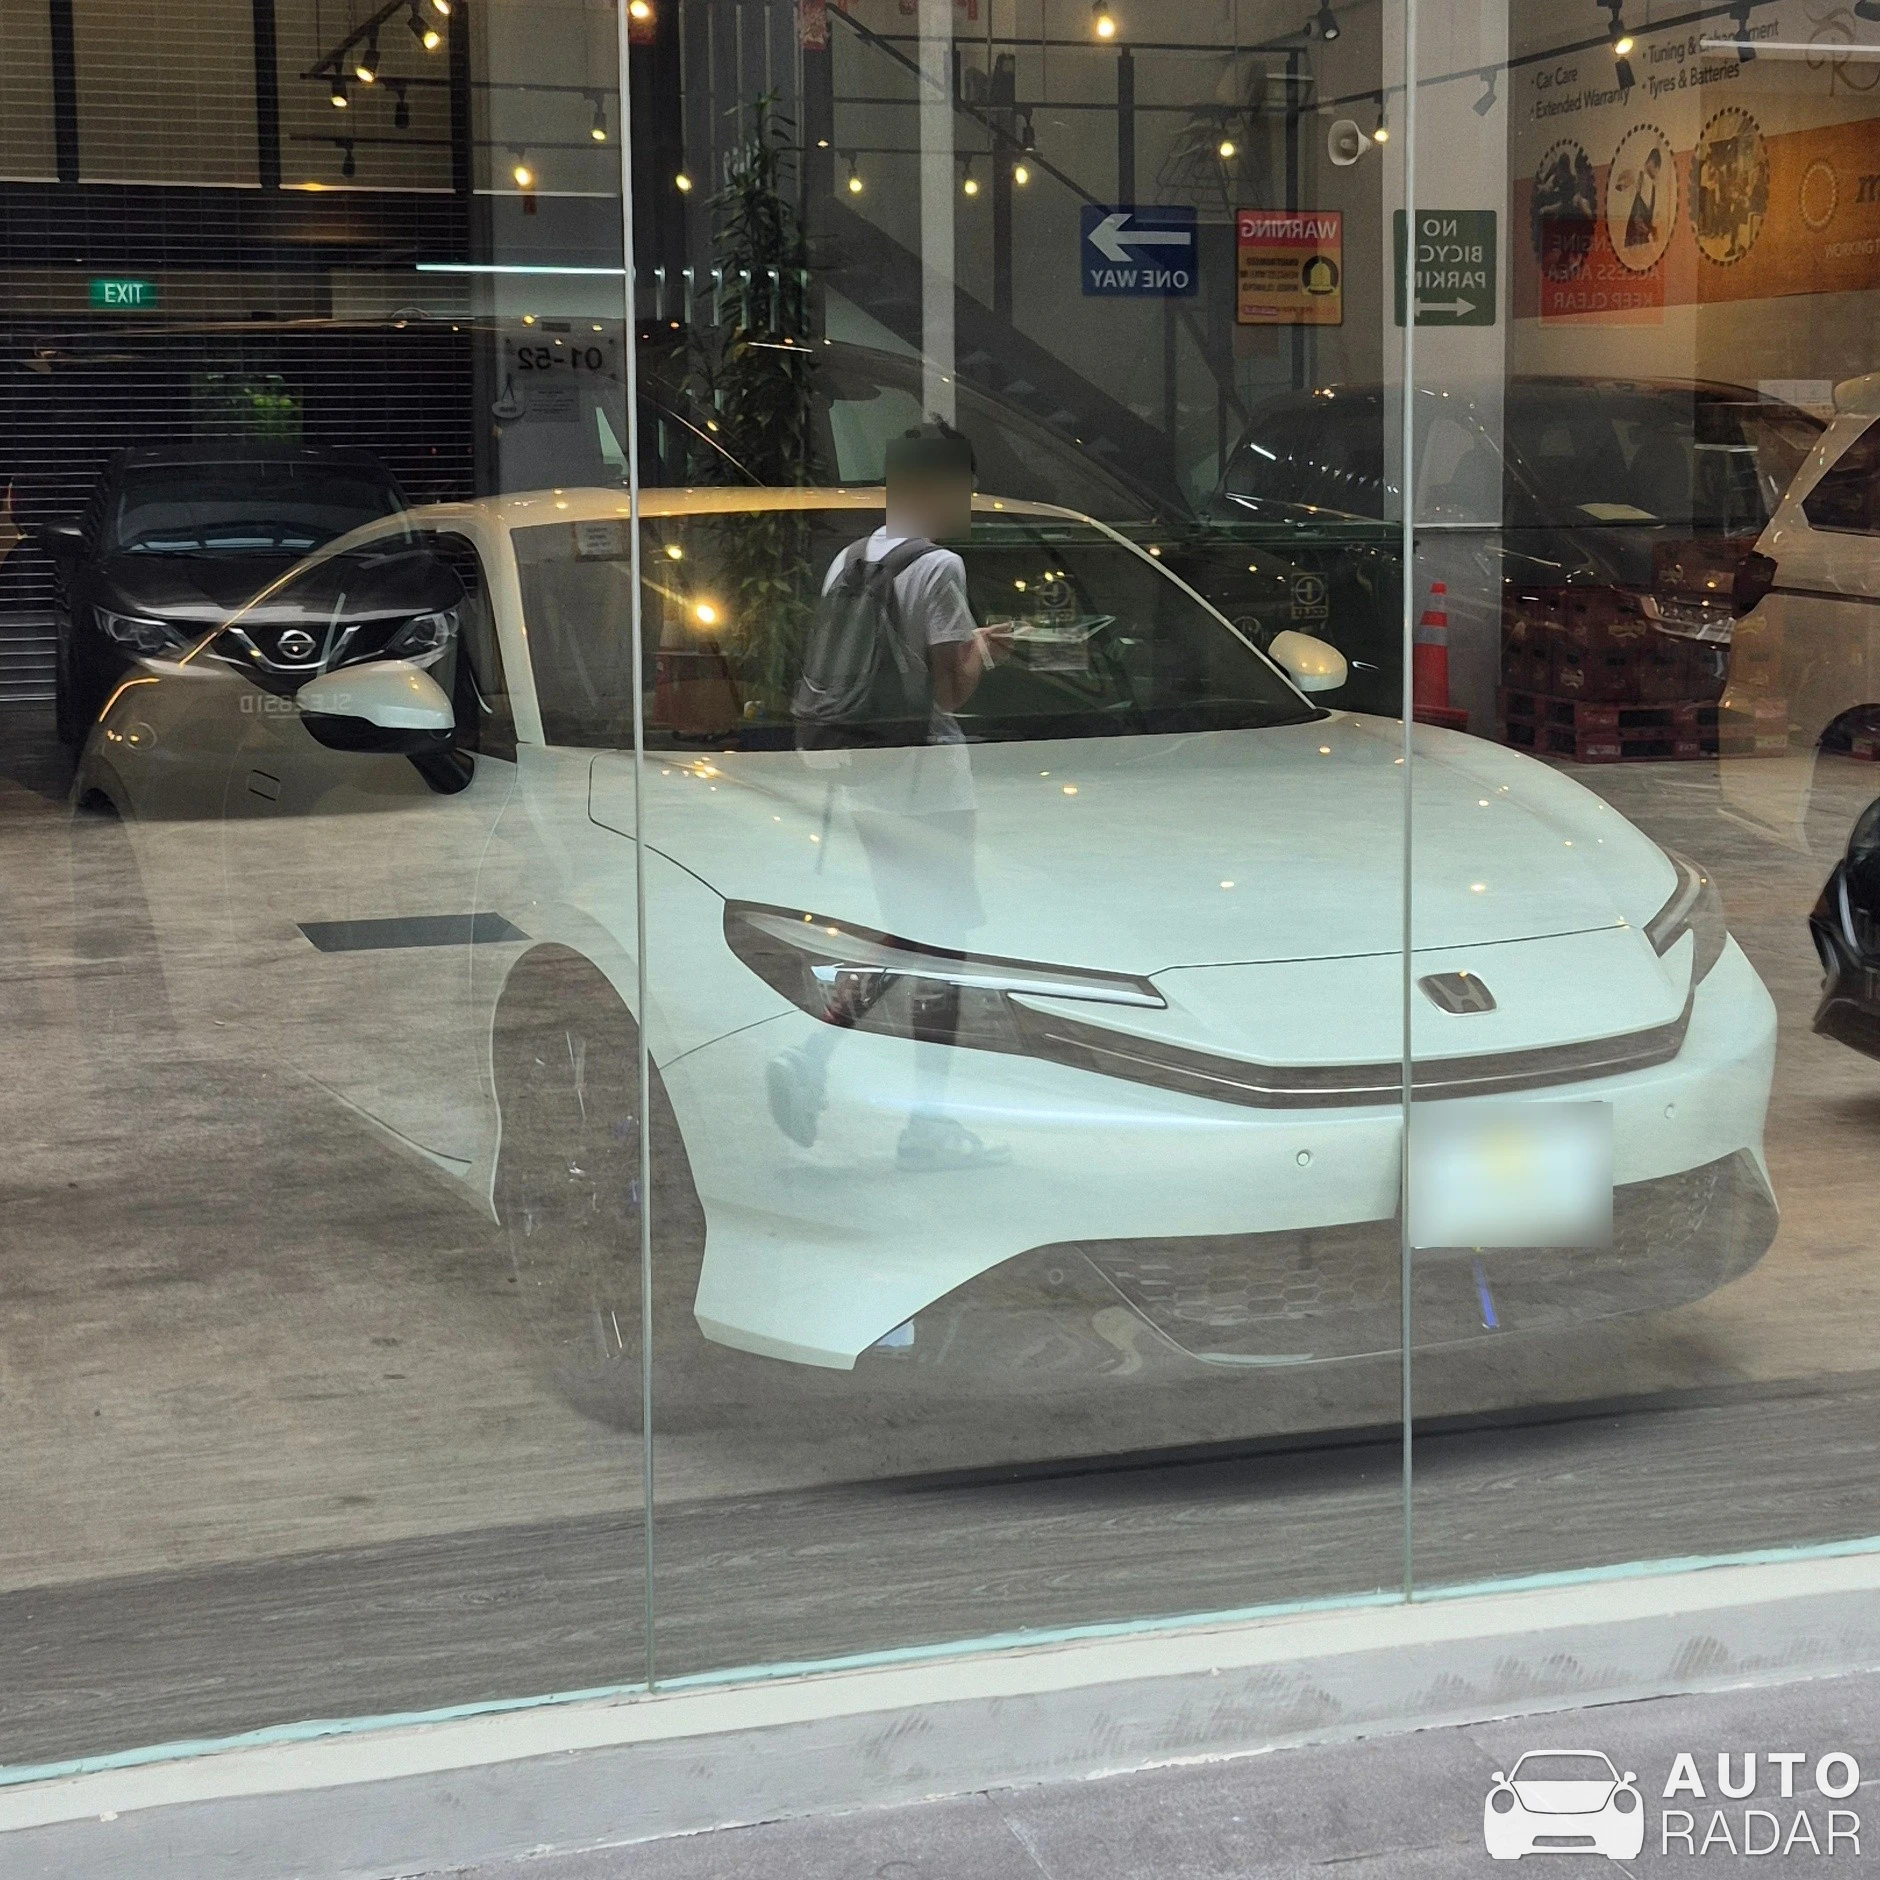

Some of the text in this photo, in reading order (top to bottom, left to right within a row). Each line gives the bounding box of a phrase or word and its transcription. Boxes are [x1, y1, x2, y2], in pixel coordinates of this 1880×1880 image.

[1648, 42, 1684, 64] Tuning
[1687, 36, 1697, 56] &
[1536, 66, 1578, 90] Car Care
[1648, 60, 1740, 101] Tyres & Batteries
[1536, 87, 1631, 119] Extended Warranty
[104, 282, 144, 304] EXIT
